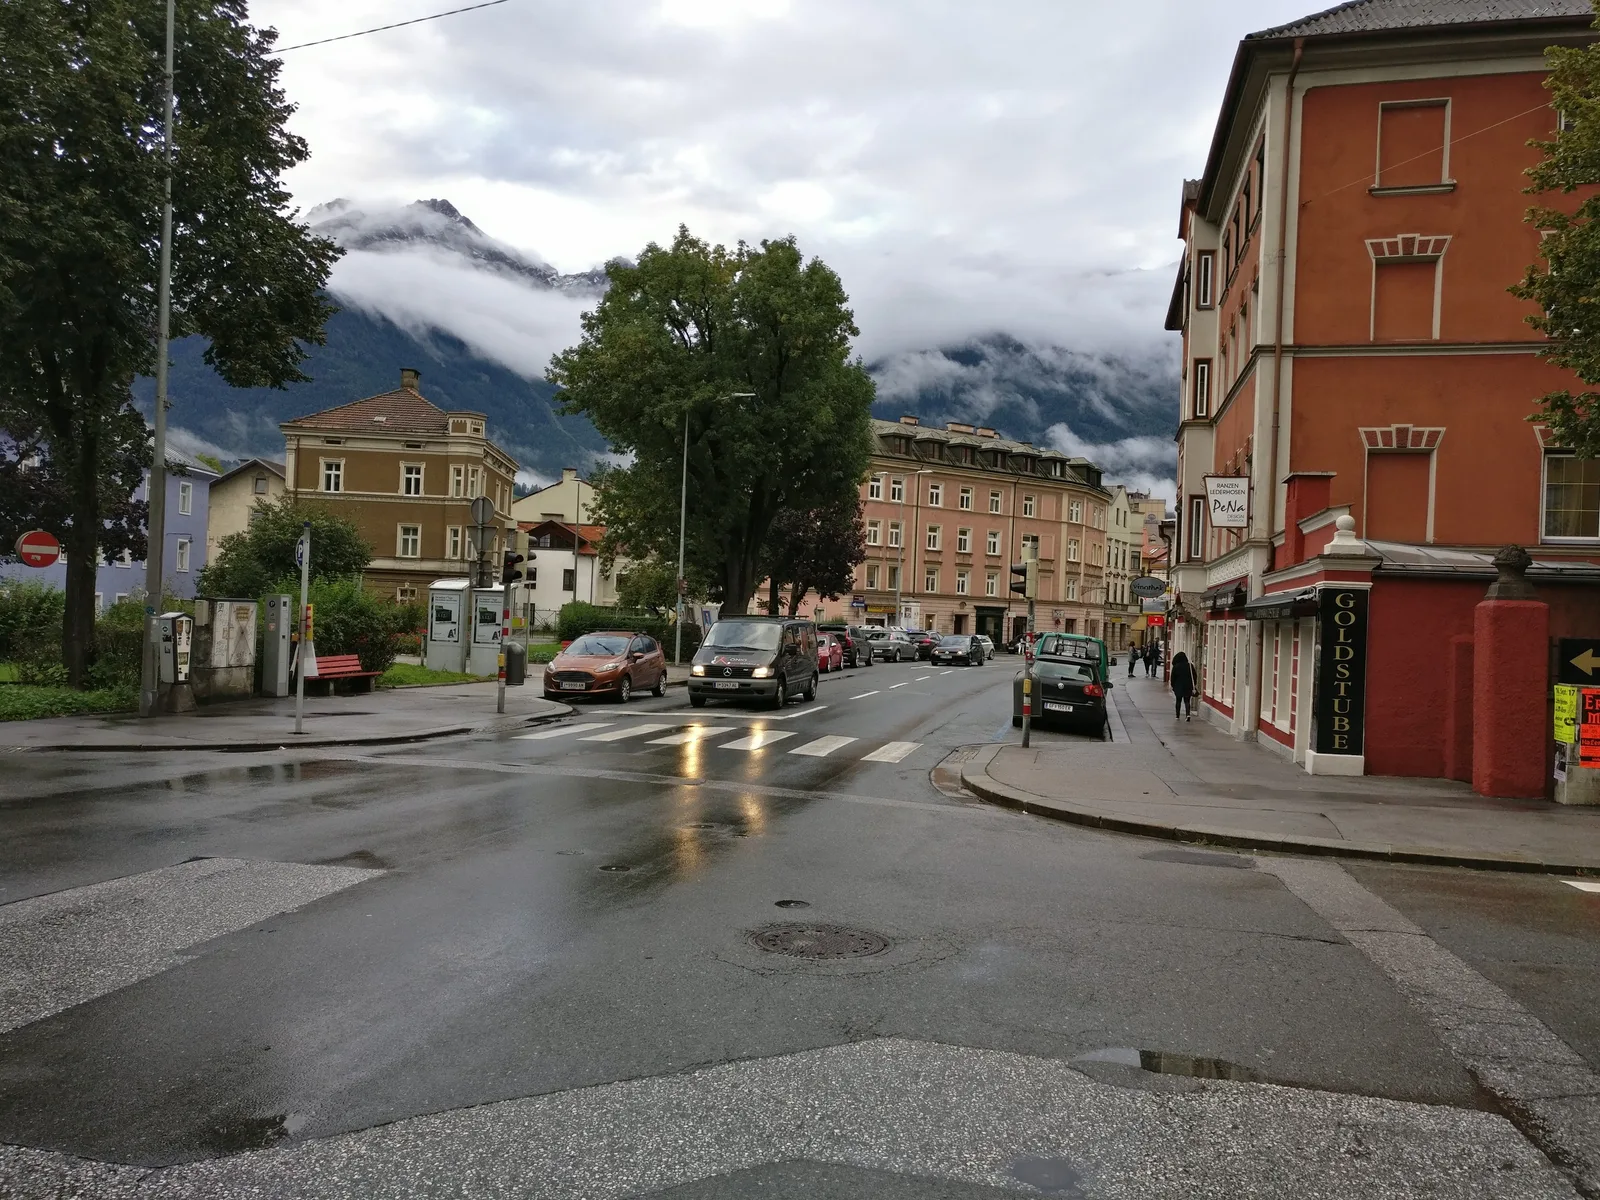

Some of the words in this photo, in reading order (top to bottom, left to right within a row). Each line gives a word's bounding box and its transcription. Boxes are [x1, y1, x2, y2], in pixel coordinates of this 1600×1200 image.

[1213, 499, 1245, 513] PeNa
[448, 628, 456, 638] A1
[1332, 592, 1356, 749] GOLDSTUBE
